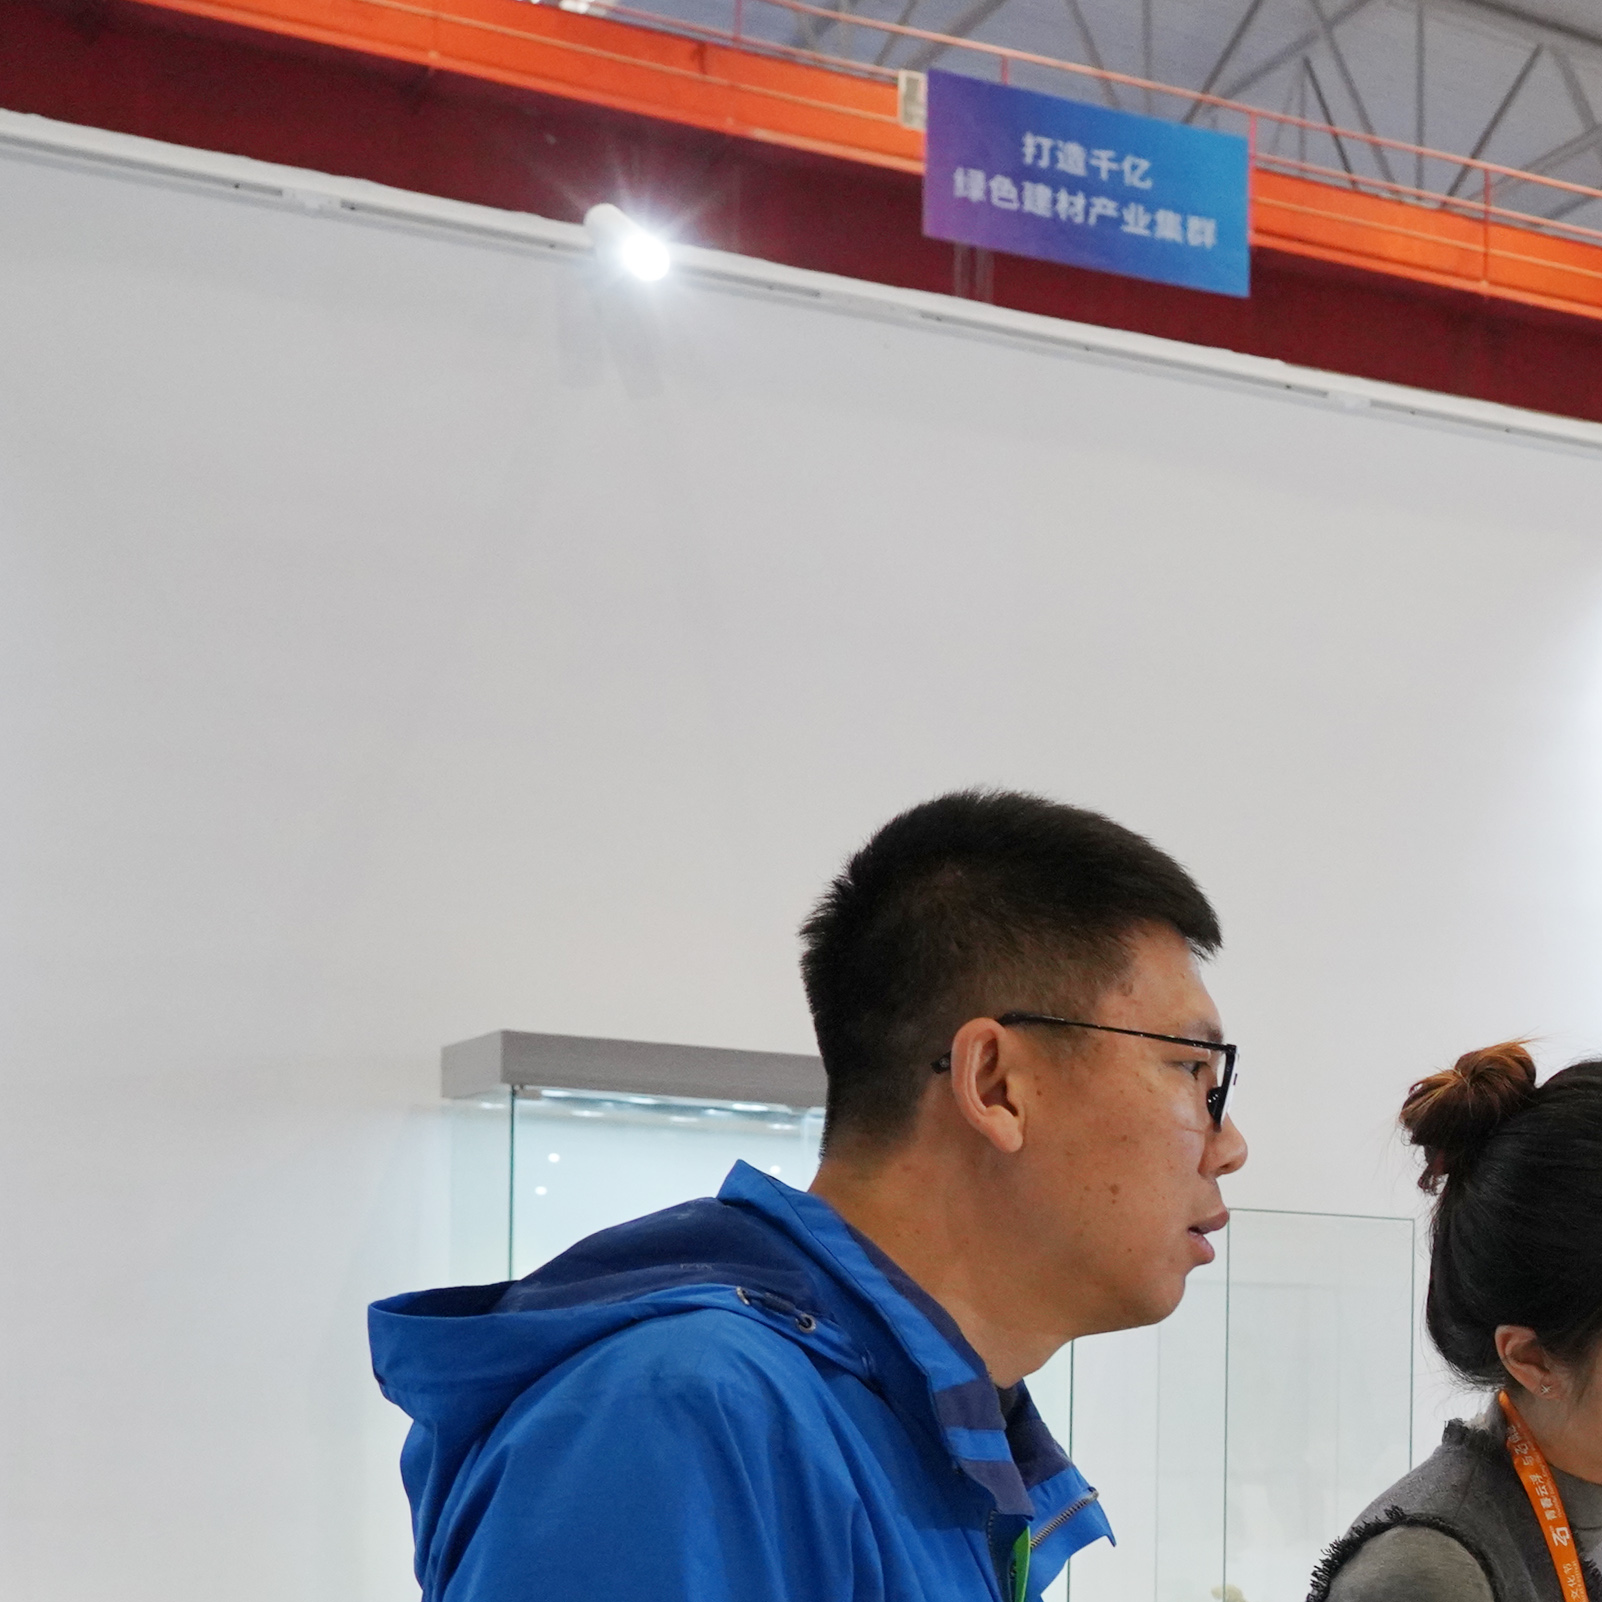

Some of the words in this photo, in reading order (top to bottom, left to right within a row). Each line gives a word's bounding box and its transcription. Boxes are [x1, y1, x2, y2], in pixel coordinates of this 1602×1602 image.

[1021, 131, 1153, 190] 打造千亿
[953, 166, 1217, 249] 绿色建材产业集群
[1528, 1471, 1557, 1521] 青春云浮
